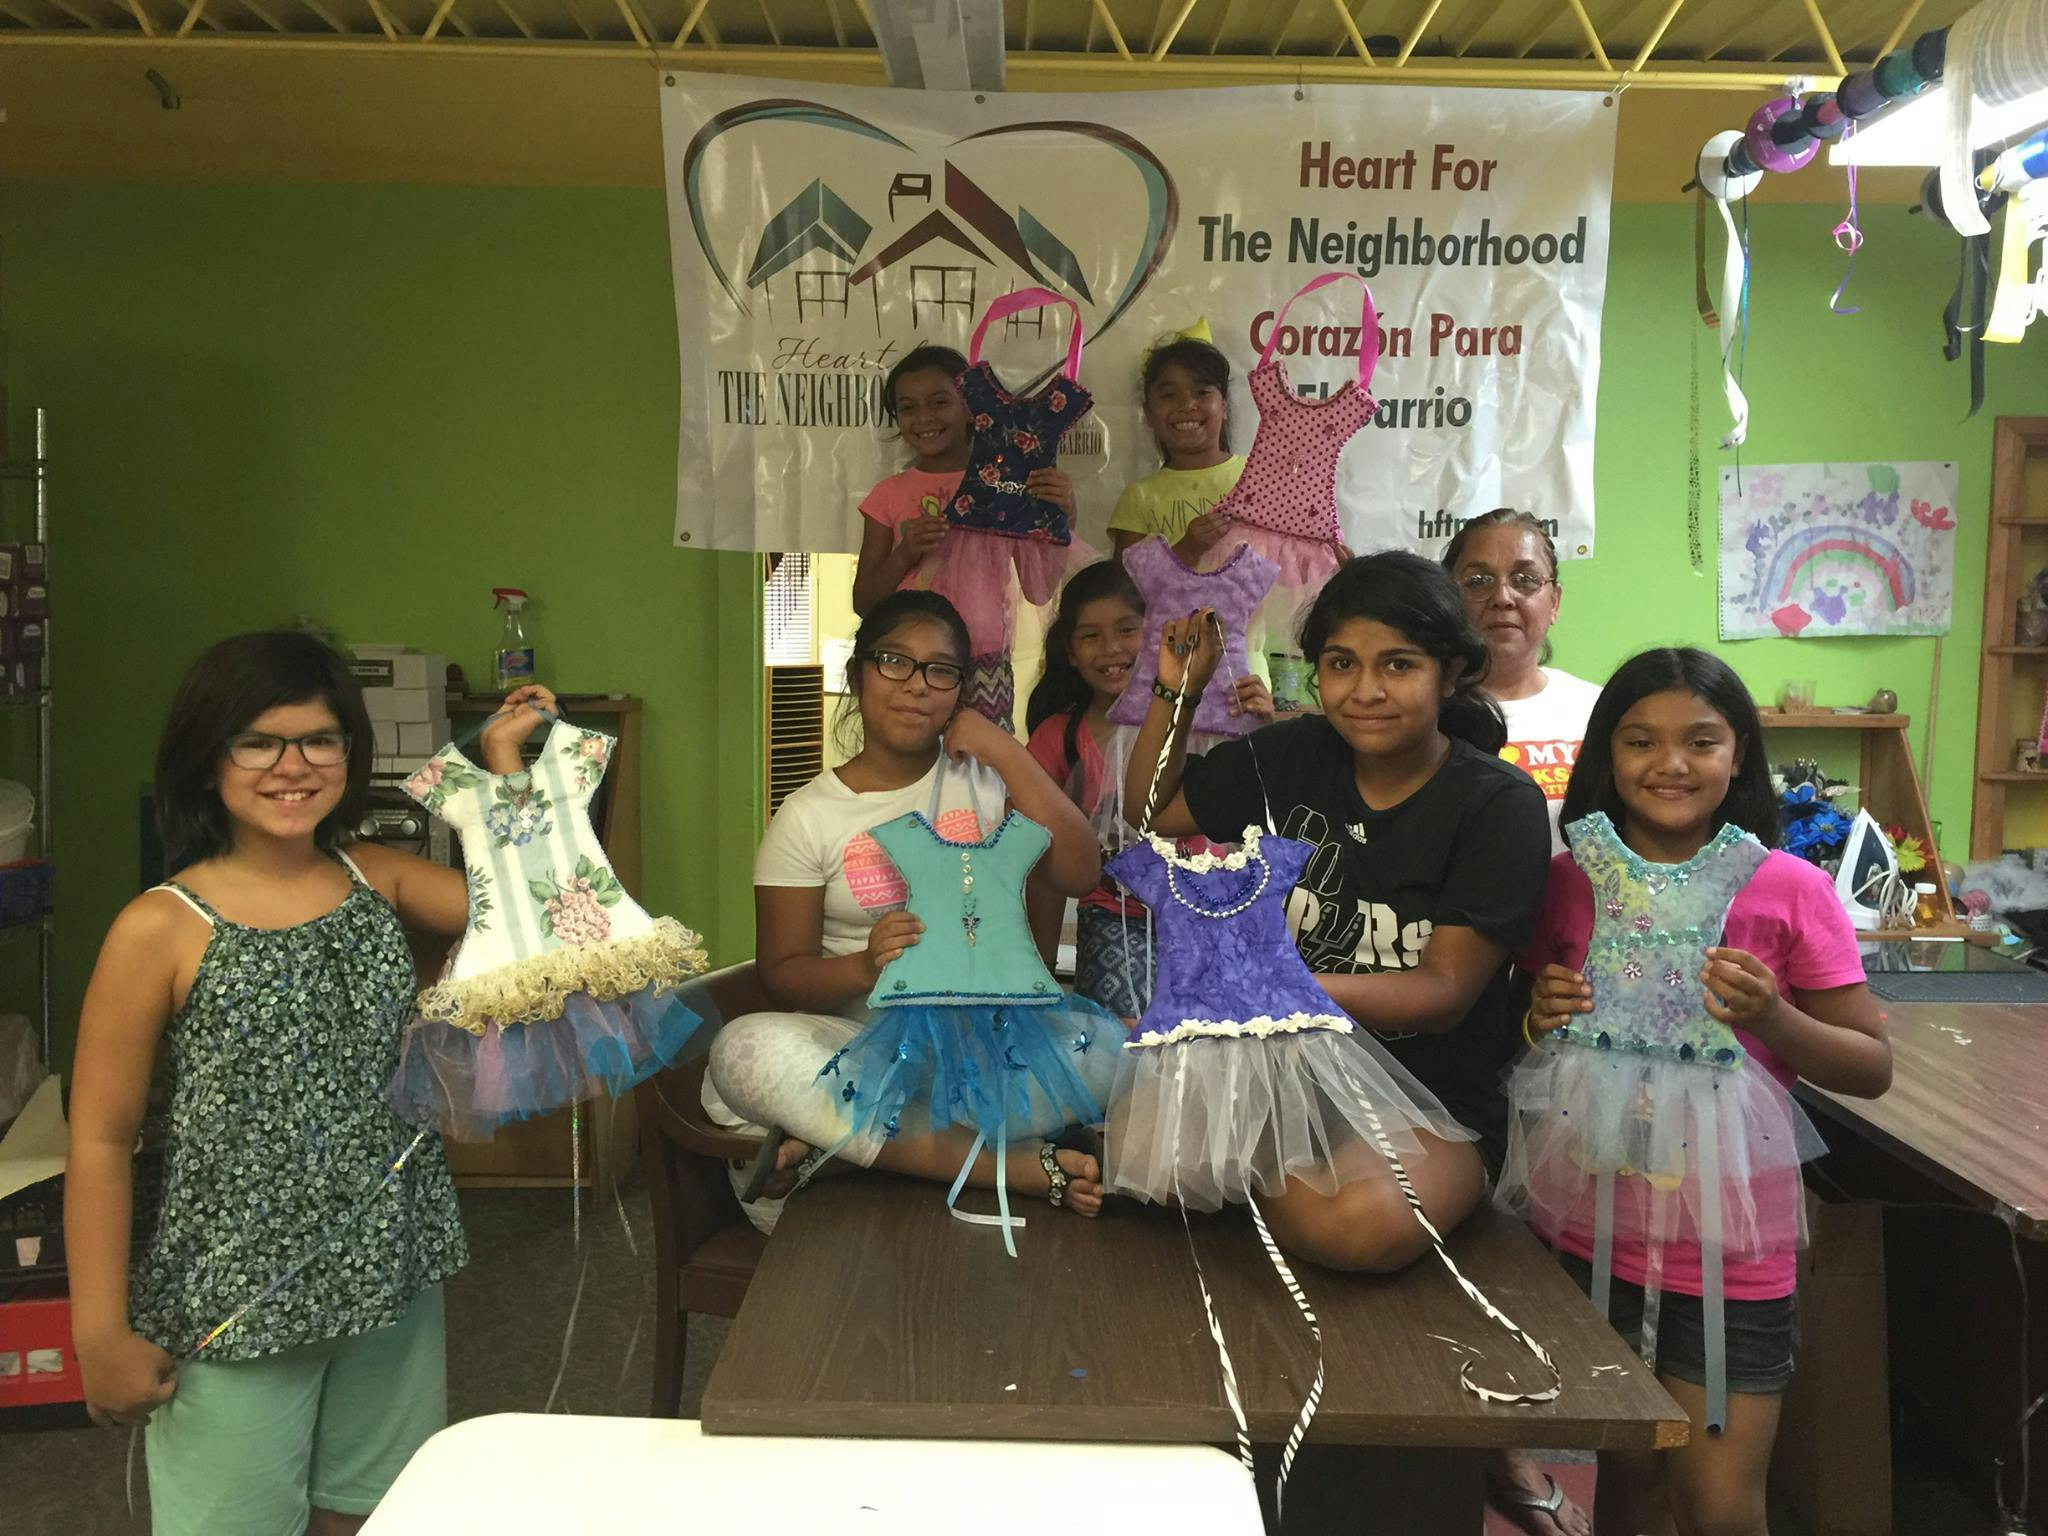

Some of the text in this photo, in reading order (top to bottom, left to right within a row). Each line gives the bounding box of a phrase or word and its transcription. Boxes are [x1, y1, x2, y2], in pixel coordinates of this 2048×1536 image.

[1300, 141, 1498, 192] Heart For
[1198, 214, 1587, 278] The Neighborhood
[771, 337, 898, 370] Heart
[1430, 313, 1523, 357] Para
[718, 370, 767, 425] THE
[1363, 386, 1472, 430] arrio
